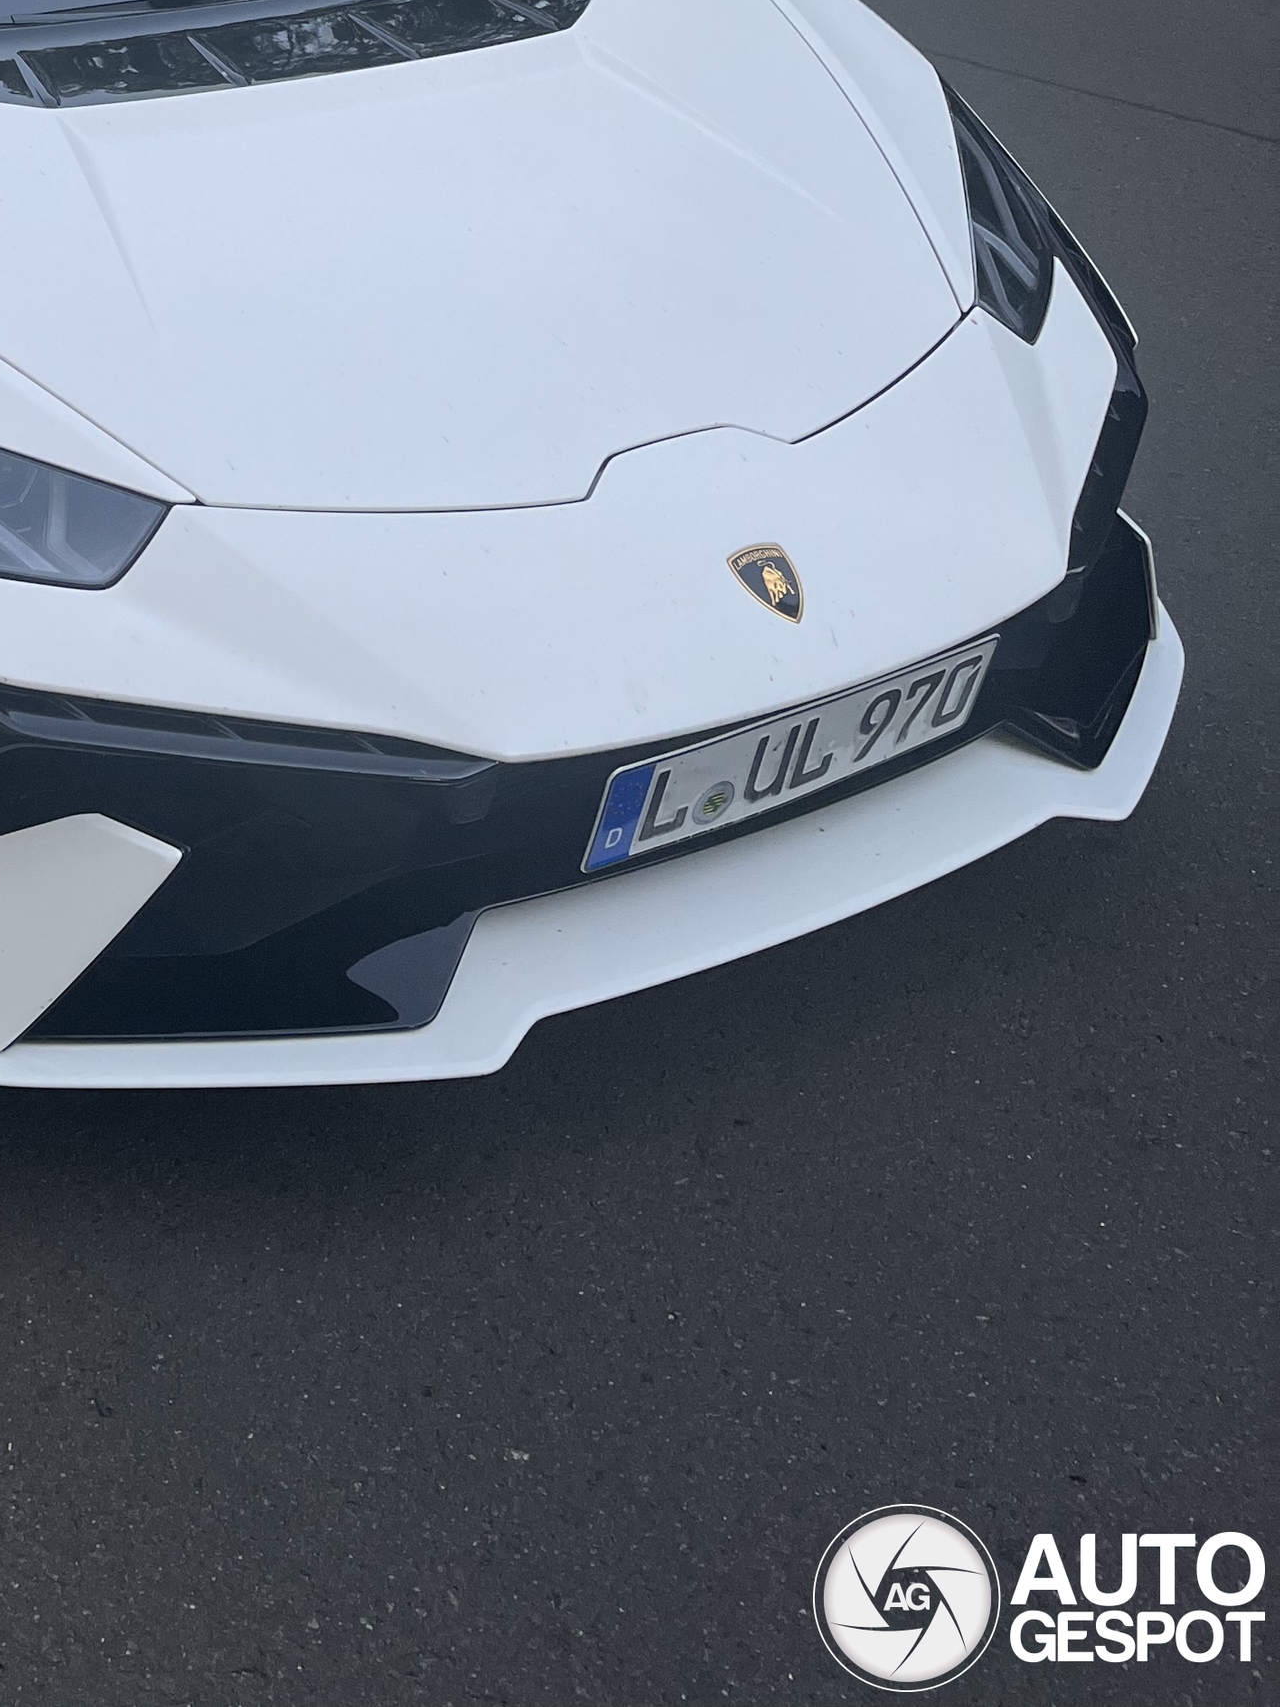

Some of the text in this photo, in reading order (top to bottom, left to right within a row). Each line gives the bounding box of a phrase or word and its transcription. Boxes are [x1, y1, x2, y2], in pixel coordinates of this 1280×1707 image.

[733, 548, 783, 571] LAMBORGHINI
[605, 654, 983, 849] D L UL 970
